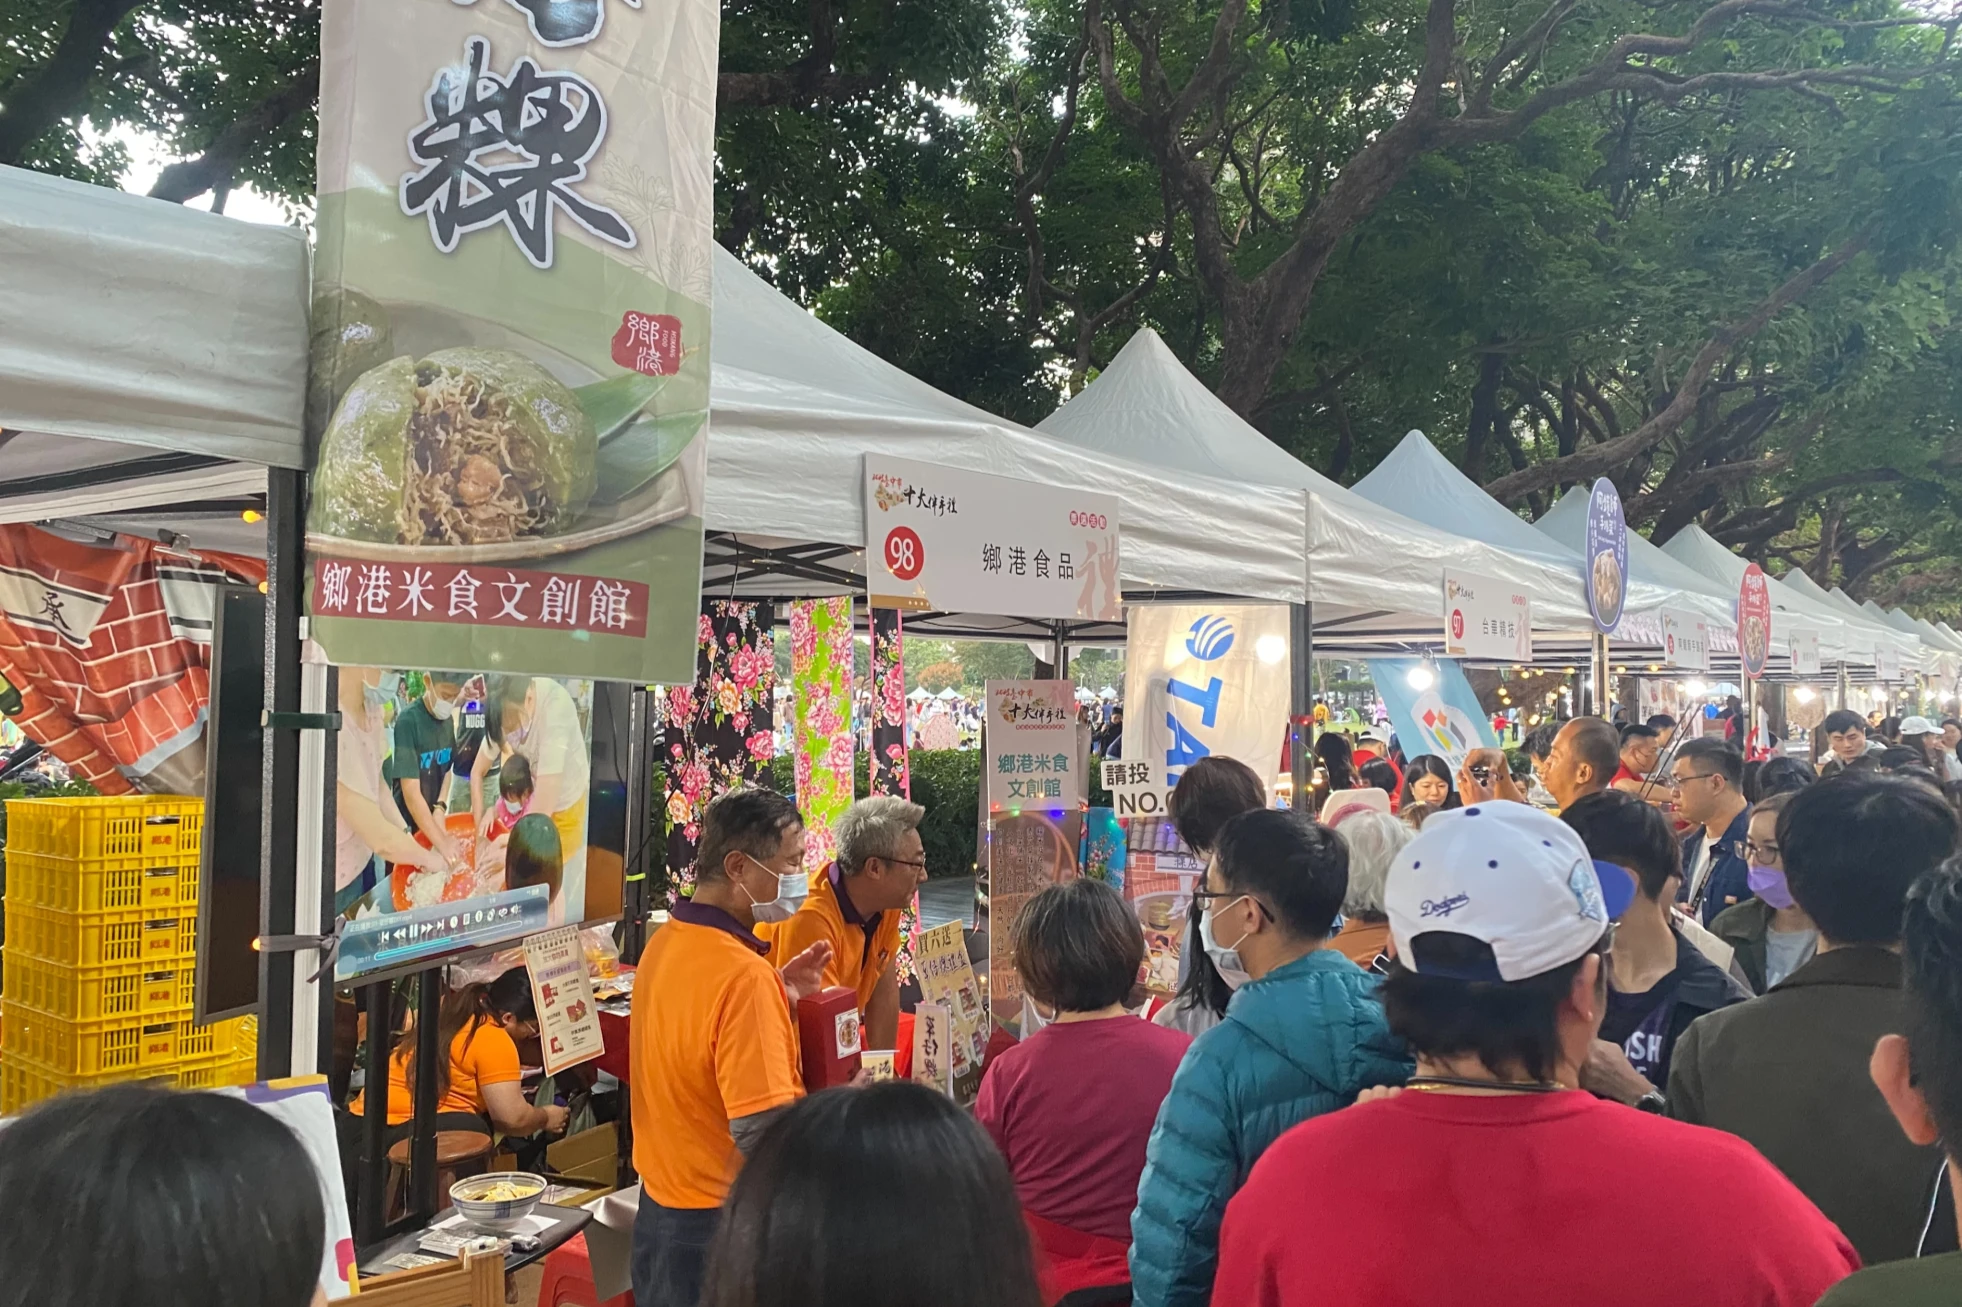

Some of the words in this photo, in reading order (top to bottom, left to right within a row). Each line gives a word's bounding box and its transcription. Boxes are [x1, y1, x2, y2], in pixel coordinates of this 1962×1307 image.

[890, 536, 915, 571] 98
[983, 543, 1075, 580] 鄉港食品
[321, 562, 632, 630] 鄉港米食文創館
[1453, 615, 1462, 634] 97
[998, 753, 1069, 774] 鄉港米食
[1106, 763, 1150, 786] 請投
[1007, 778, 1061, 799] 文創館
[1119, 791, 1174, 815] NO.
[1420, 891, 1470, 918] Dodgers
[919, 925, 962, 955] 買六送一
